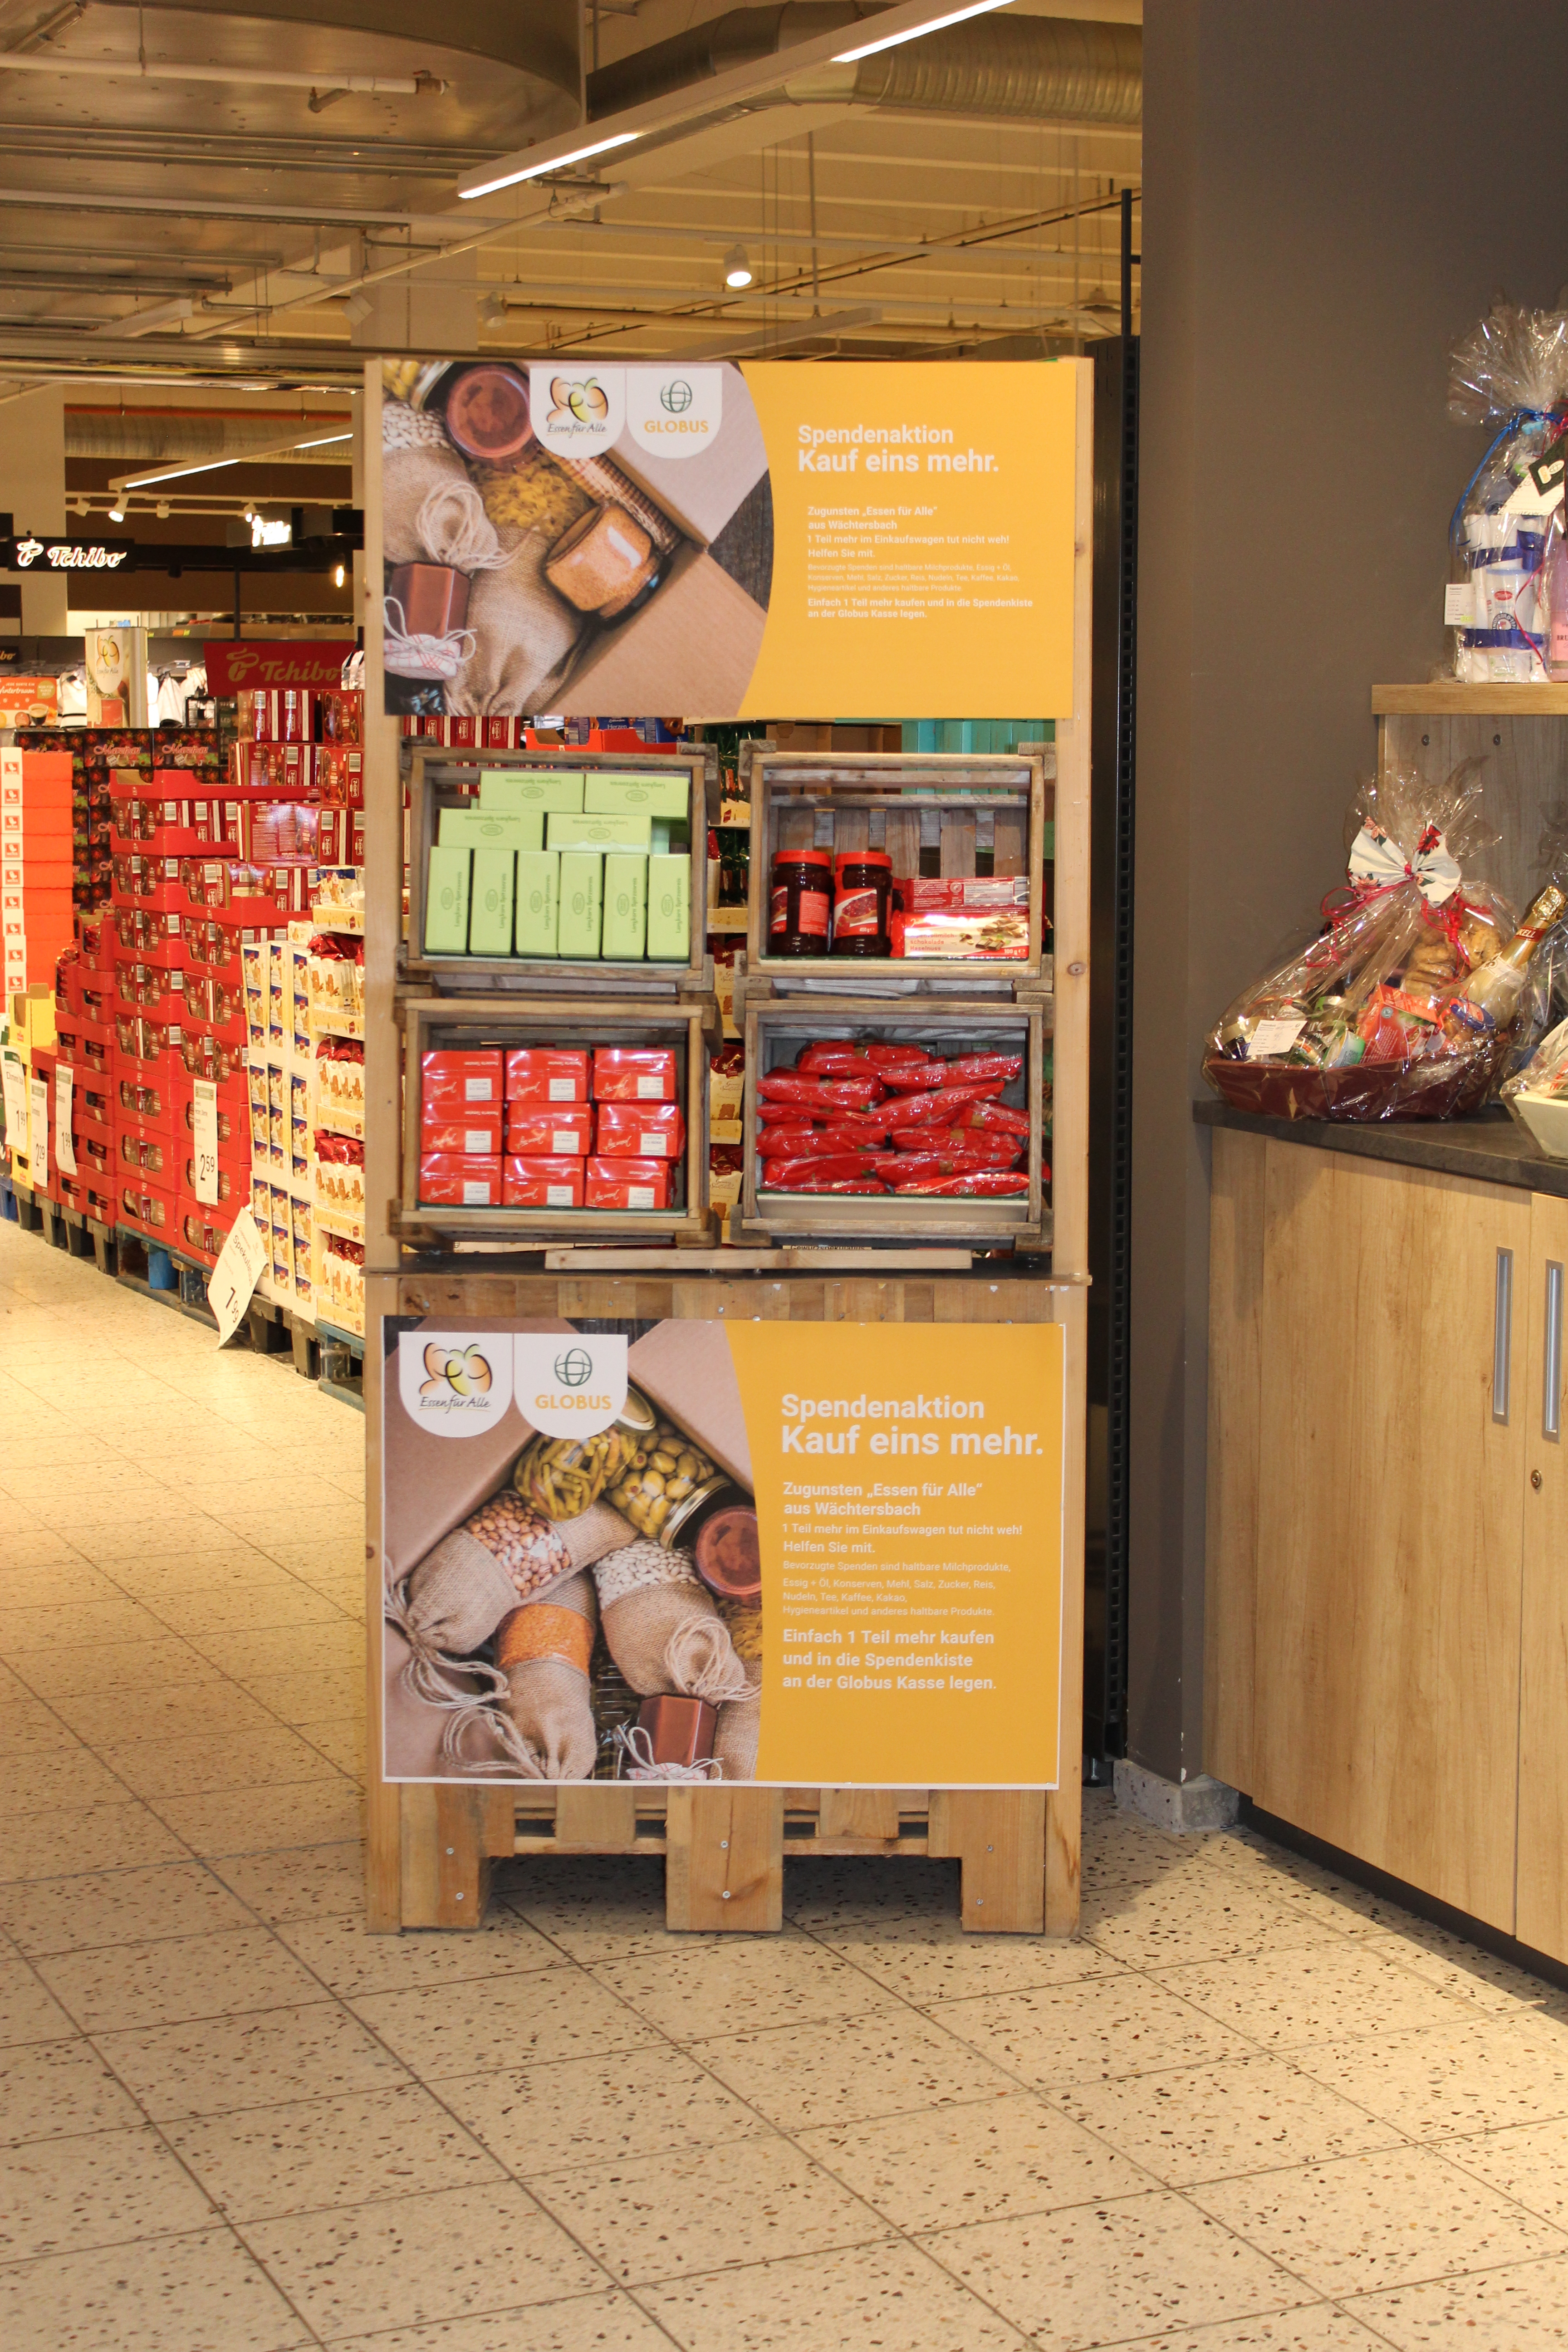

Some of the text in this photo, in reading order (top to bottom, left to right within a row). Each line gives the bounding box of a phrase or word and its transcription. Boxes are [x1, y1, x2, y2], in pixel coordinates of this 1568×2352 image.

[548, 421, 608, 439] Essen für Alle
[644, 420, 709, 434] GLOBUS
[798, 424, 954, 448] Spendenaktion
[799, 448, 999, 472] Kauf eins mehr.
[808, 506, 860, 518] Zugunsten
[897, 506, 912, 516] für
[828, 520, 897, 529] Wächtersbach
[815, 534, 832, 544] Teil
[833, 534, 858, 544] mehr
[874, 534, 945, 547] Einkaufswagen
[946, 535, 960, 544] tut
[961, 535, 985, 544] nicht
[987, 534, 1009, 544] weh!
[47, 546, 127, 568] Tchibo
[808, 549, 875, 558] Helfen Sie mit.
[808, 598, 841, 607] Einfach
[851, 598, 867, 607] Teil
[869, 598, 892, 607] mehr
[894, 598, 926, 608] kaufen
[927, 598, 944, 607] und
[946, 598, 955, 607] in
[956, 598, 970, 607] die
[973, 598, 1033, 608] Spendenkiste
[821, 609, 836, 618] der
[838, 609, 869, 618] Globus
[871, 609, 898, 618] Kasse
[900, 609, 927, 620] legen.
[259, 661, 342, 682] Tchibo
[233, 1235, 253, 1287] Spekulatius
[419, 1394, 492, 1415] Essen für Alle
[535, 1394, 612, 1410] GLOBUS
[781, 1393, 985, 1423] Spendenaktion
[782, 1424, 1043, 1455] Kauf eins mehr.
[783, 1481, 863, 1499] Zugunsten
[921, 1482, 944, 1497] für
[784, 1501, 921, 1516] aus Wächtersbach
[792, 1523, 812, 1534] Teil
[814, 1524, 843, 1534] mehr
[845, 1524, 860, 1534] im
[862, 1523, 946, 1537] Einkaufswagen
[948, 1525, 964, 1535] tut
[966, 1524, 994, 1535] nicht
[996, 1524, 1023, 1535] weh!
[784, 1540, 875, 1553] Helfen Sie mit.
[783, 1560, 1012, 1573] Bevorzugte Spenden sind haltbare Milchprodukte,
[783, 1578, 808, 1589] Essig
[818, 1577, 832, 1589] Öl,
[833, 1579, 885, 1590] Konserven,
[886, 1579, 912, 1590] Mehl,
[914, 1579, 936, 1590] Salz,
[938, 1579, 972, 1590] Zucker,
[973, 1580, 996, 1590] Reis,
[783, 1592, 908, 1603] Nudeln, Tee, Kaffee, Kakao,
[783, 1606, 995, 1616] Hygieneartikel und anderes haltbare Produkte.
[783, 1628, 842, 1644] Einfach
[861, 1630, 890, 1644] Teil
[895, 1630, 936, 1644] mehr
[940, 1629, 995, 1645] kaufen
[783, 1651, 973, 1670] und in die Spendenkiste
[782, 1674, 996, 1692] an der Globus Kasse legen.
